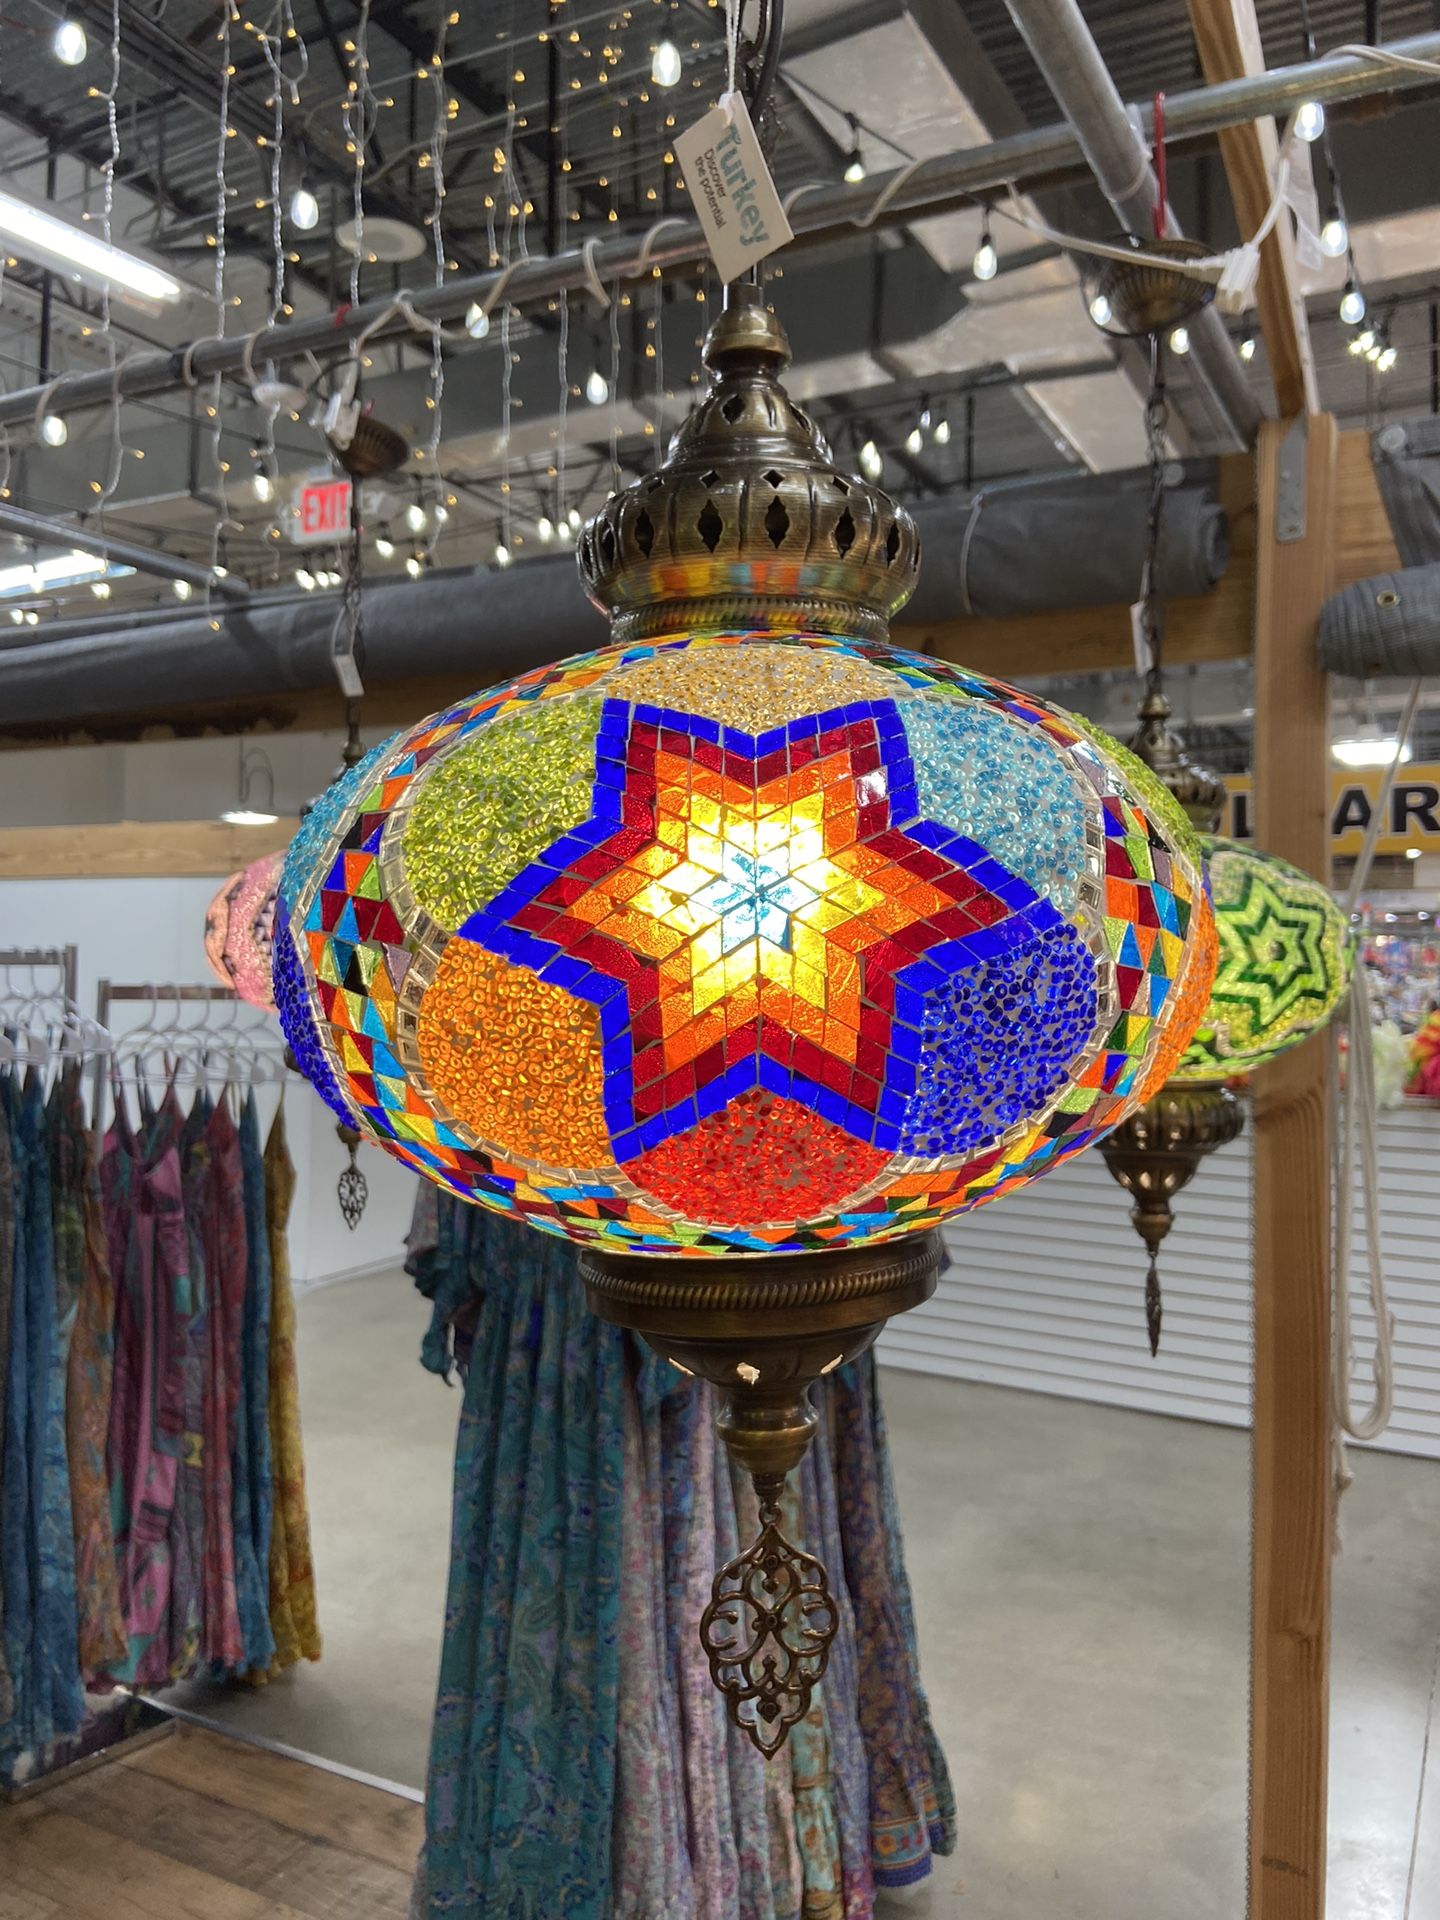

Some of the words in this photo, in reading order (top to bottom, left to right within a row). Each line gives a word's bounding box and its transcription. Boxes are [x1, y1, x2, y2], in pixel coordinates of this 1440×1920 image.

[695, 156, 706, 178] the
[704, 149, 727, 198] Discover
[717, 124, 769, 247] Turkey
[700, 178, 727, 229] potential
[303, 483, 350, 533] EXIT
